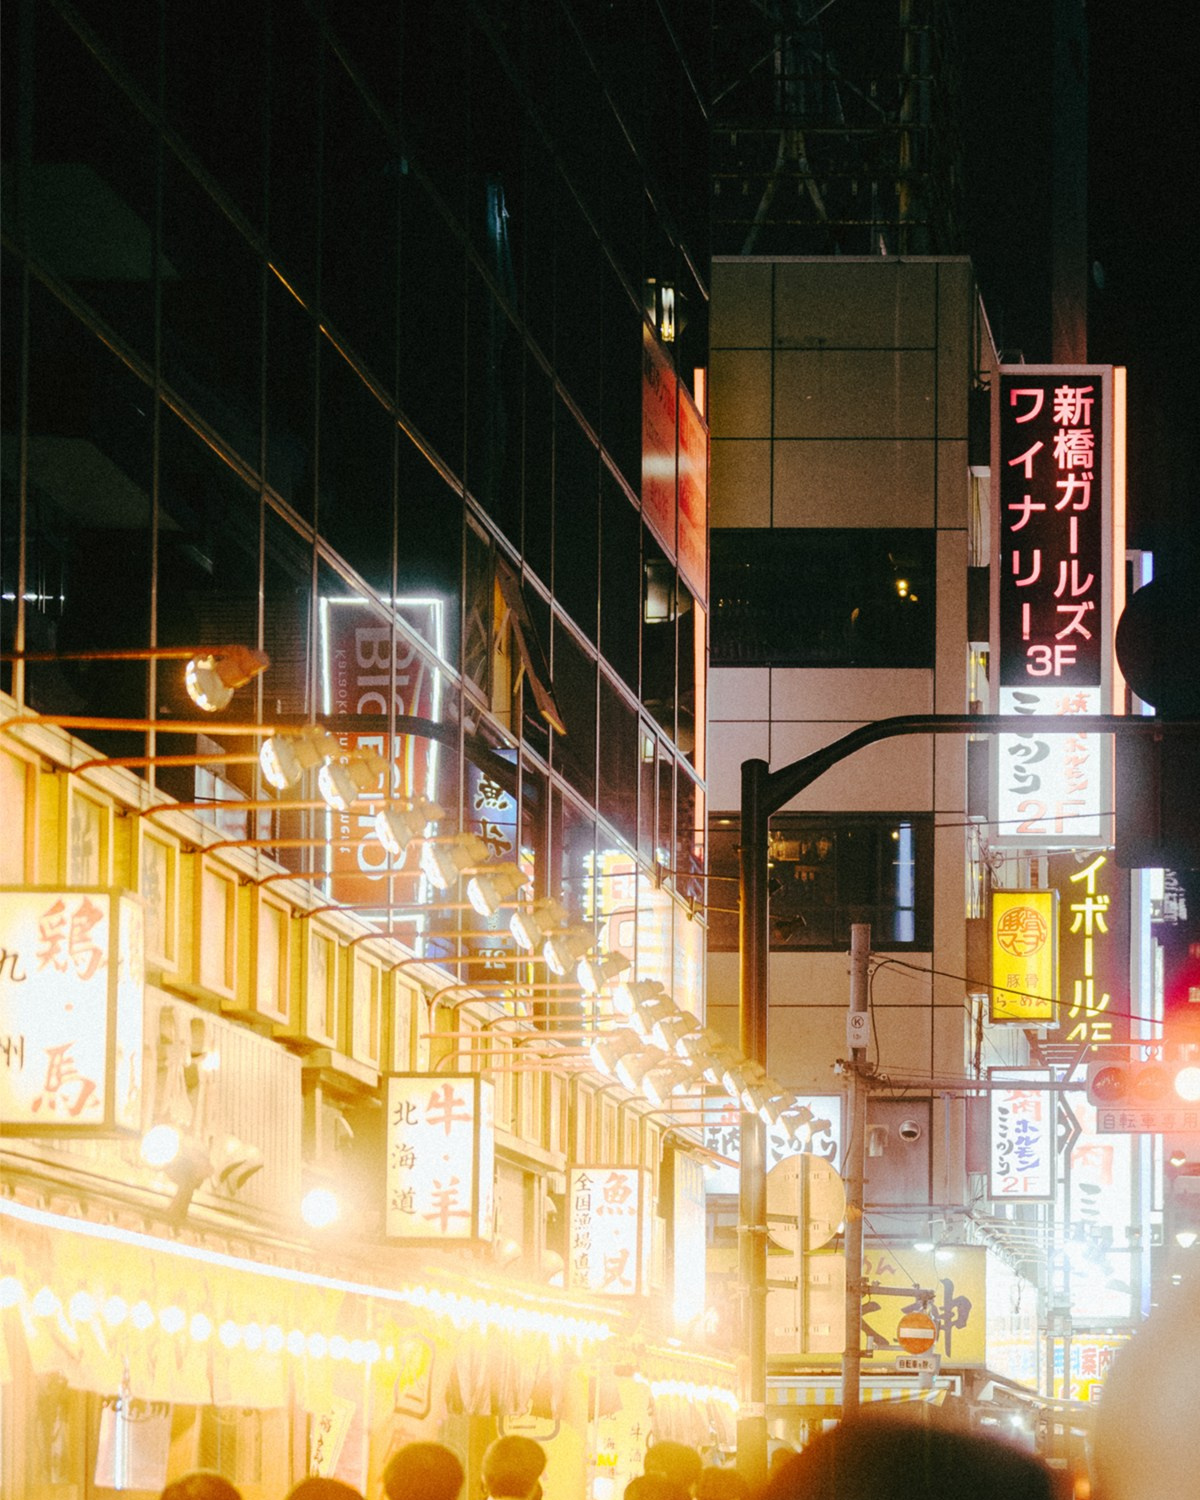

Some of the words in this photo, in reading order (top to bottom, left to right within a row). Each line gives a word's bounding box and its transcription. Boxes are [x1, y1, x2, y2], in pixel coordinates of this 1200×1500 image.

[1007, 388, 1046, 641] ワイナリー
[1052, 383, 1095, 642] 新橋ガールズ
[1026, 644, 1077, 676] 3F
[1055, 691, 1091, 795] 焼ホルモン
[1015, 799, 1086, 834] 2F
[31, 895, 108, 1117] 鶏・馬
[1007, 973, 1039, 988] 豚骨
[995, 1106, 1015, 1177] ここから
[1014, 1118, 1041, 1173] ホルモン
[1102, 1111, 1199, 1131] 自転車専用
[391, 1100, 419, 1215] 北海道
[422, 1082, 473, 1234] 牛・羊
[1001, 1175, 1040, 1193] 2F
